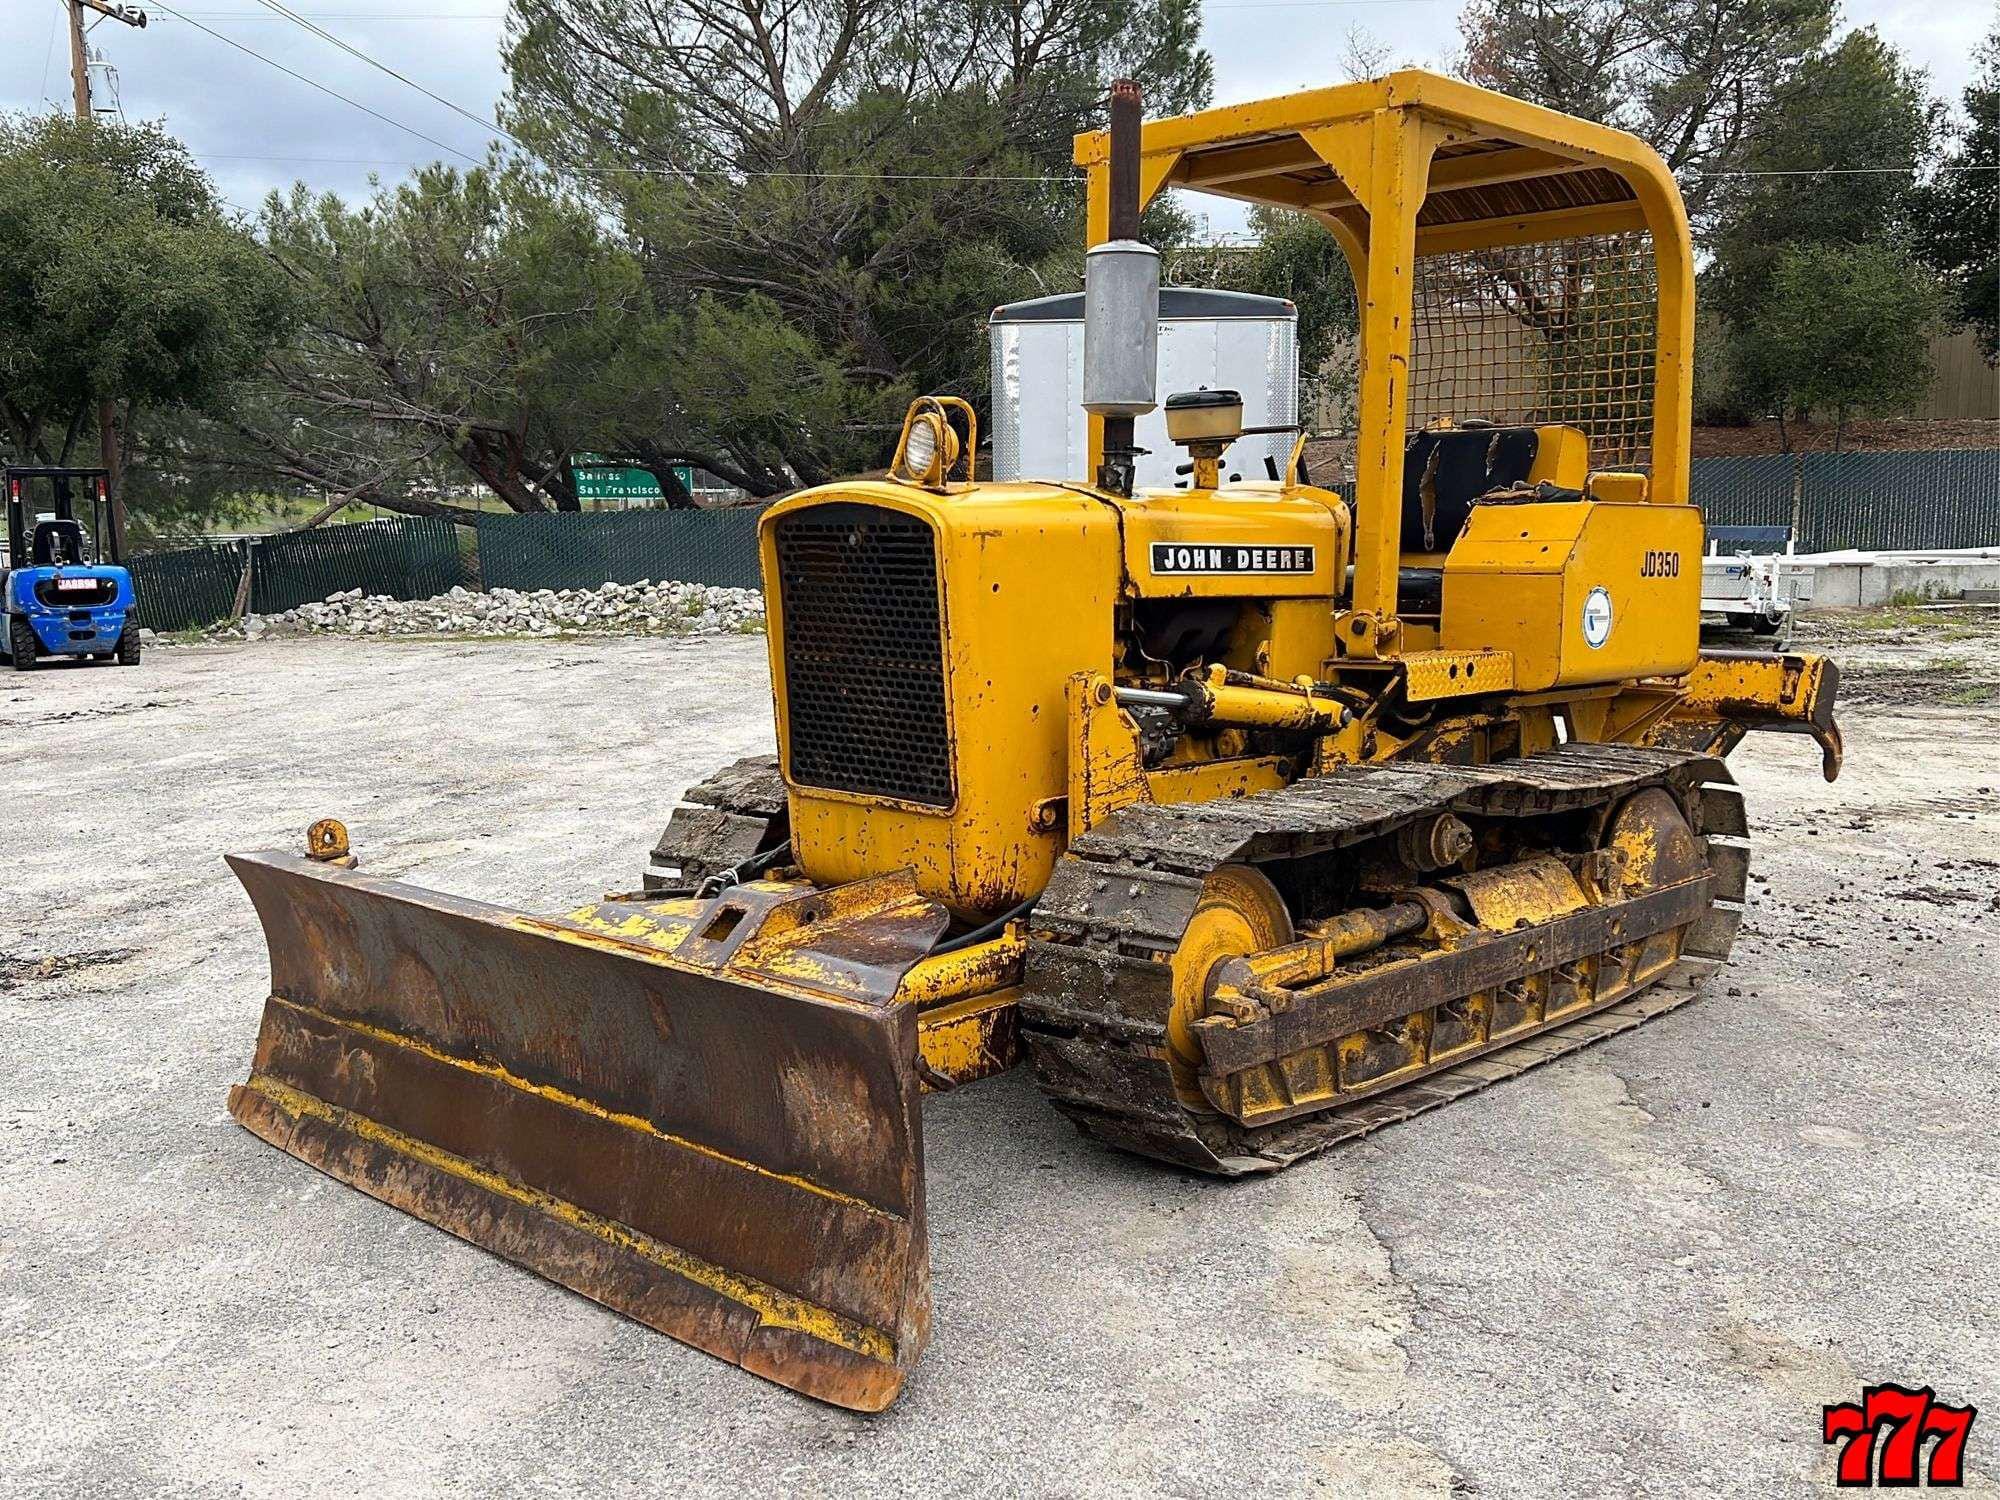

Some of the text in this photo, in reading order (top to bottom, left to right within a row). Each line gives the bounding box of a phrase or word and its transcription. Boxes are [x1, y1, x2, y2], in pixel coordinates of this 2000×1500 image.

[579, 485, 661, 495] San Francisco
[1164, 548, 1305, 569] JOHN DEERE
[1640, 551, 1679, 578] JD350
